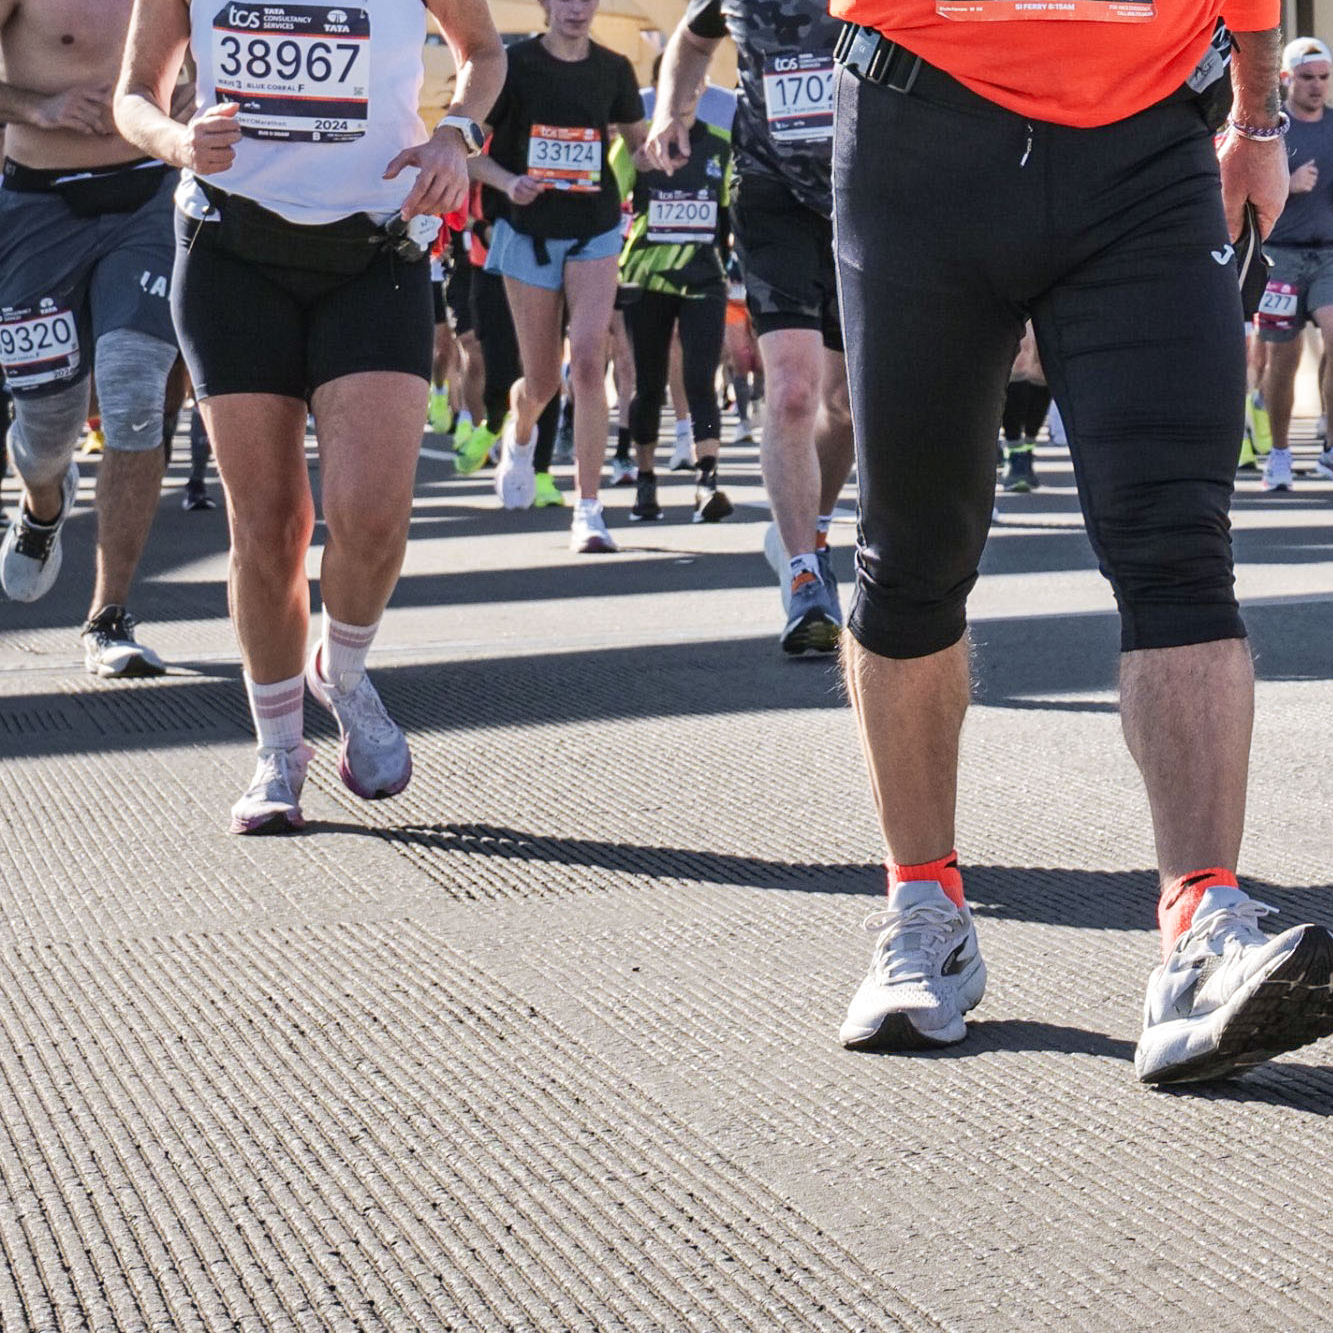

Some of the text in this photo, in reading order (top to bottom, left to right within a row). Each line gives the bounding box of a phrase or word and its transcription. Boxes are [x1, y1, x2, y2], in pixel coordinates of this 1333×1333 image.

[228, 4, 261, 29] tcs
[263, 7, 285, 15] TATA
[263, 15, 313, 24] CONSULTANCY
[263, 22, 295, 30] SERVICES
[323, 23, 350, 33] TATA
[220, 35, 361, 83] 38967
[774, 57, 799, 72] tcs
[235, 80, 242, 89] 3
[775, 73, 833, 107] 170
[314, 119, 348, 130] 2024
[536, 140, 594, 163] 33124
[657, 203, 711, 220] 17200
[0, 318, 71, 355] 9320
